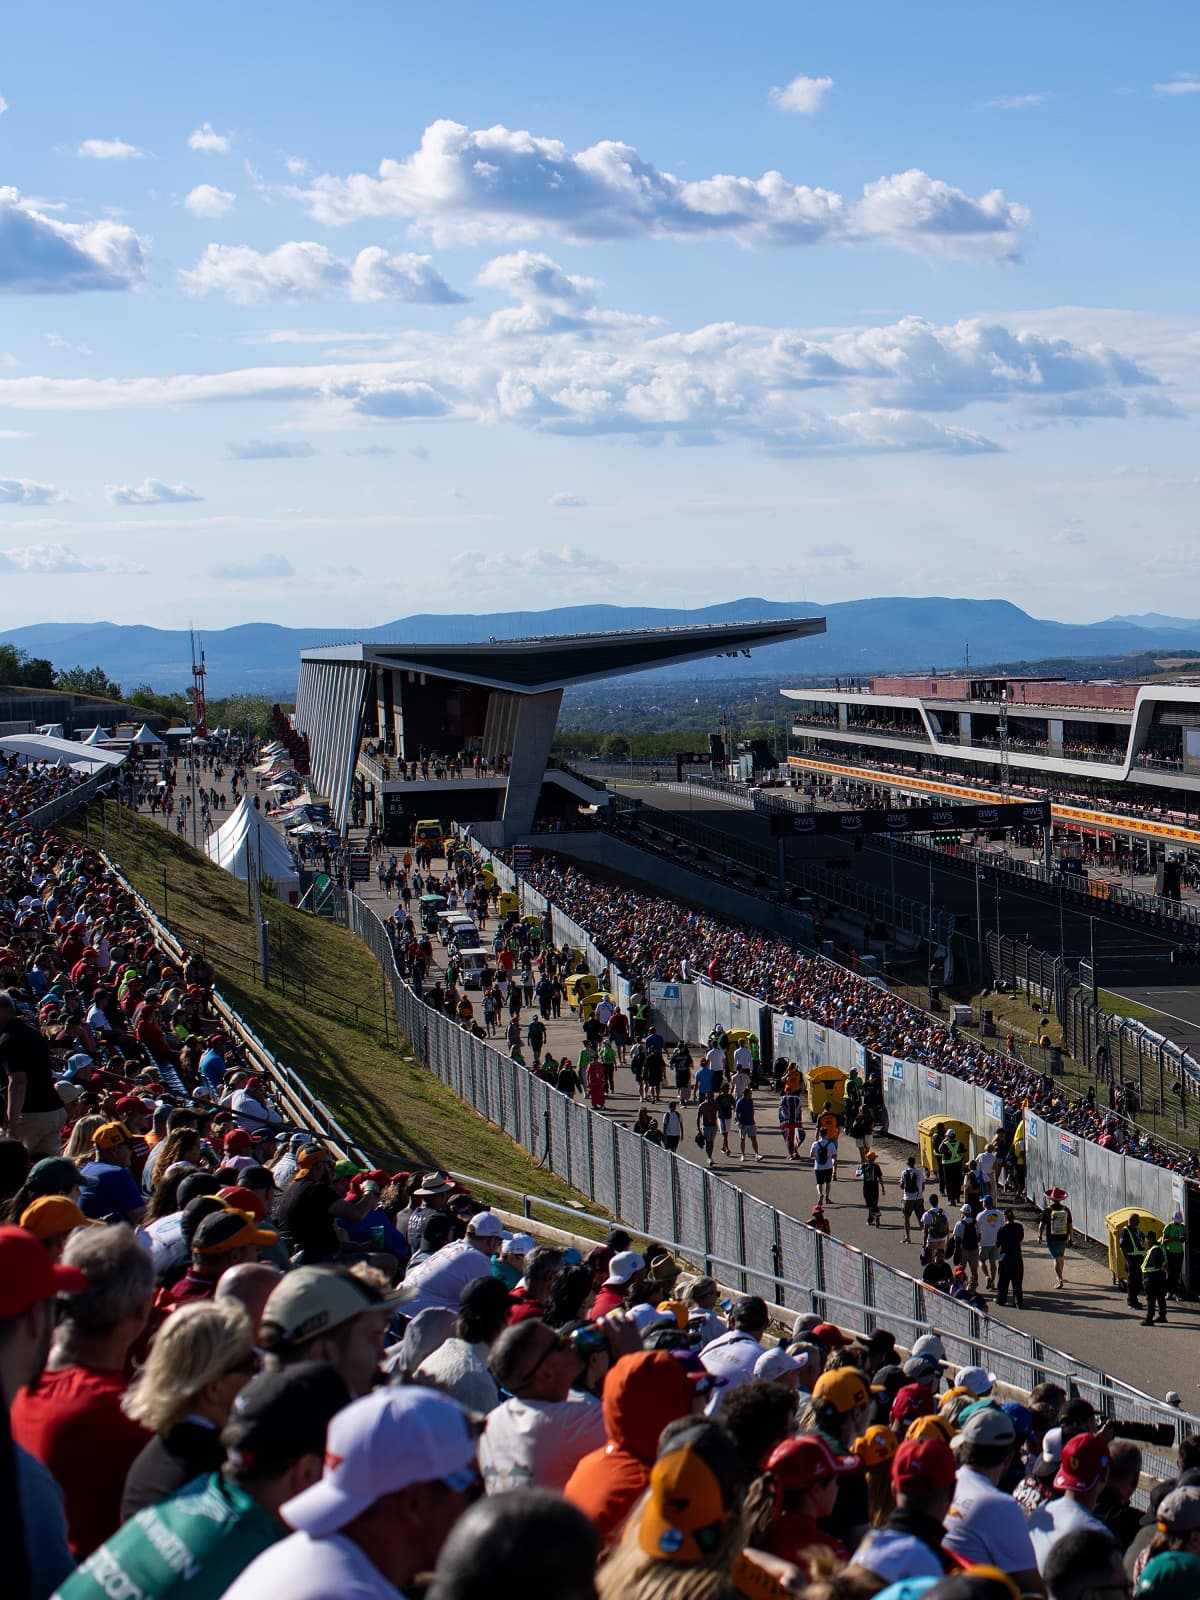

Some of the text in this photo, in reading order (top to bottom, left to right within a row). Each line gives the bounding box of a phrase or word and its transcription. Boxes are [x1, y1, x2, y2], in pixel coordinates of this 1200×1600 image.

[932, 811, 953, 820] aws
[978, 808, 998, 817] aws
[1023, 806, 1043, 816] aws
[794, 817, 815, 826] aws
[841, 815, 861, 825] aws
[887, 813, 907, 822] aws
